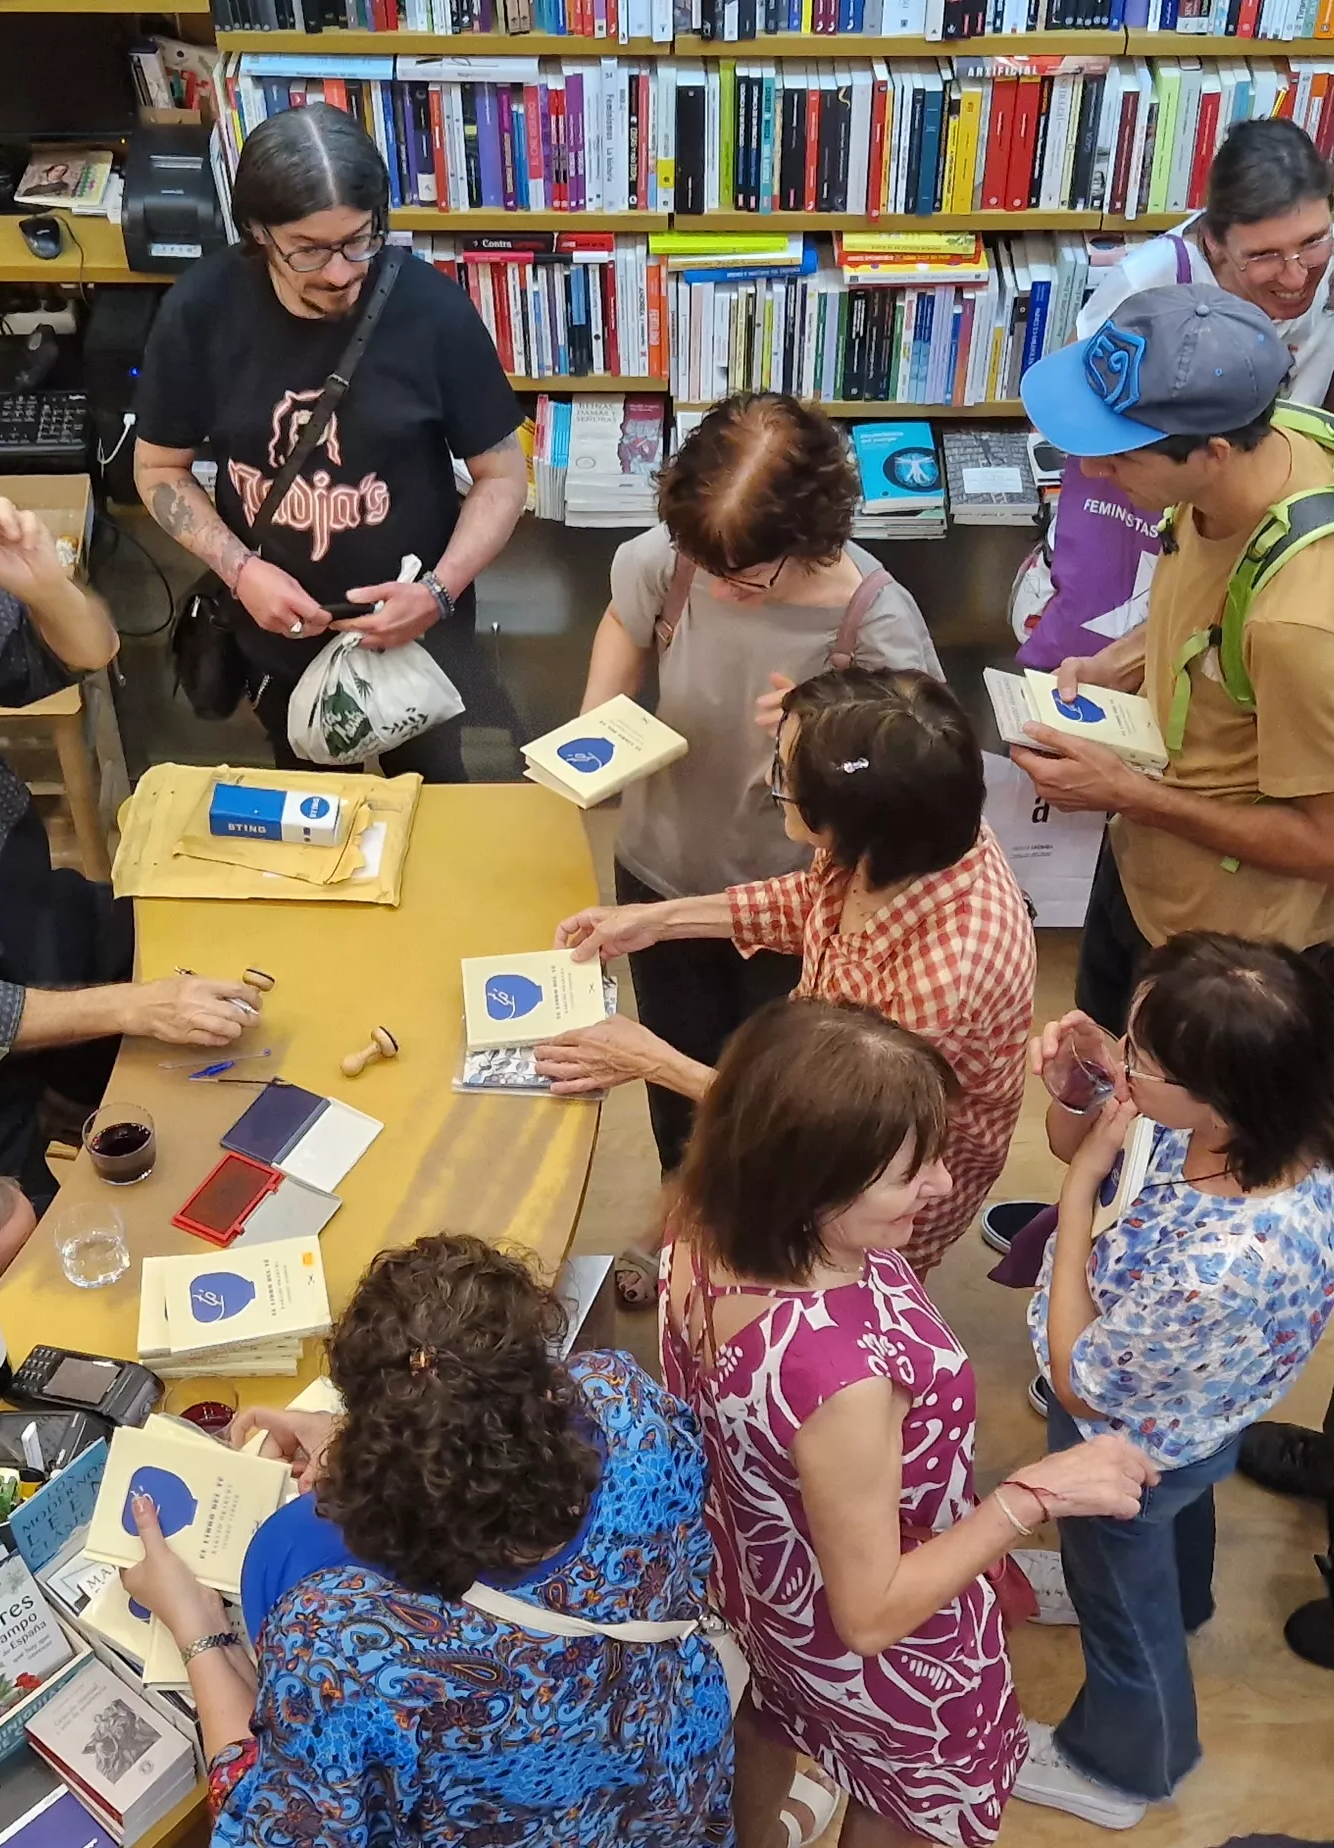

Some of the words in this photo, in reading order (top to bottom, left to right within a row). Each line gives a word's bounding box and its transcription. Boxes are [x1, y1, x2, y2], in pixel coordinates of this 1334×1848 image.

[482, 239, 512, 249] Contra
[227, 822, 267, 835] STING
[199, 1548, 206, 1560] EL
[203, 1512, 215, 1545] LIBRO
[10, 1619, 47, 1651] España
